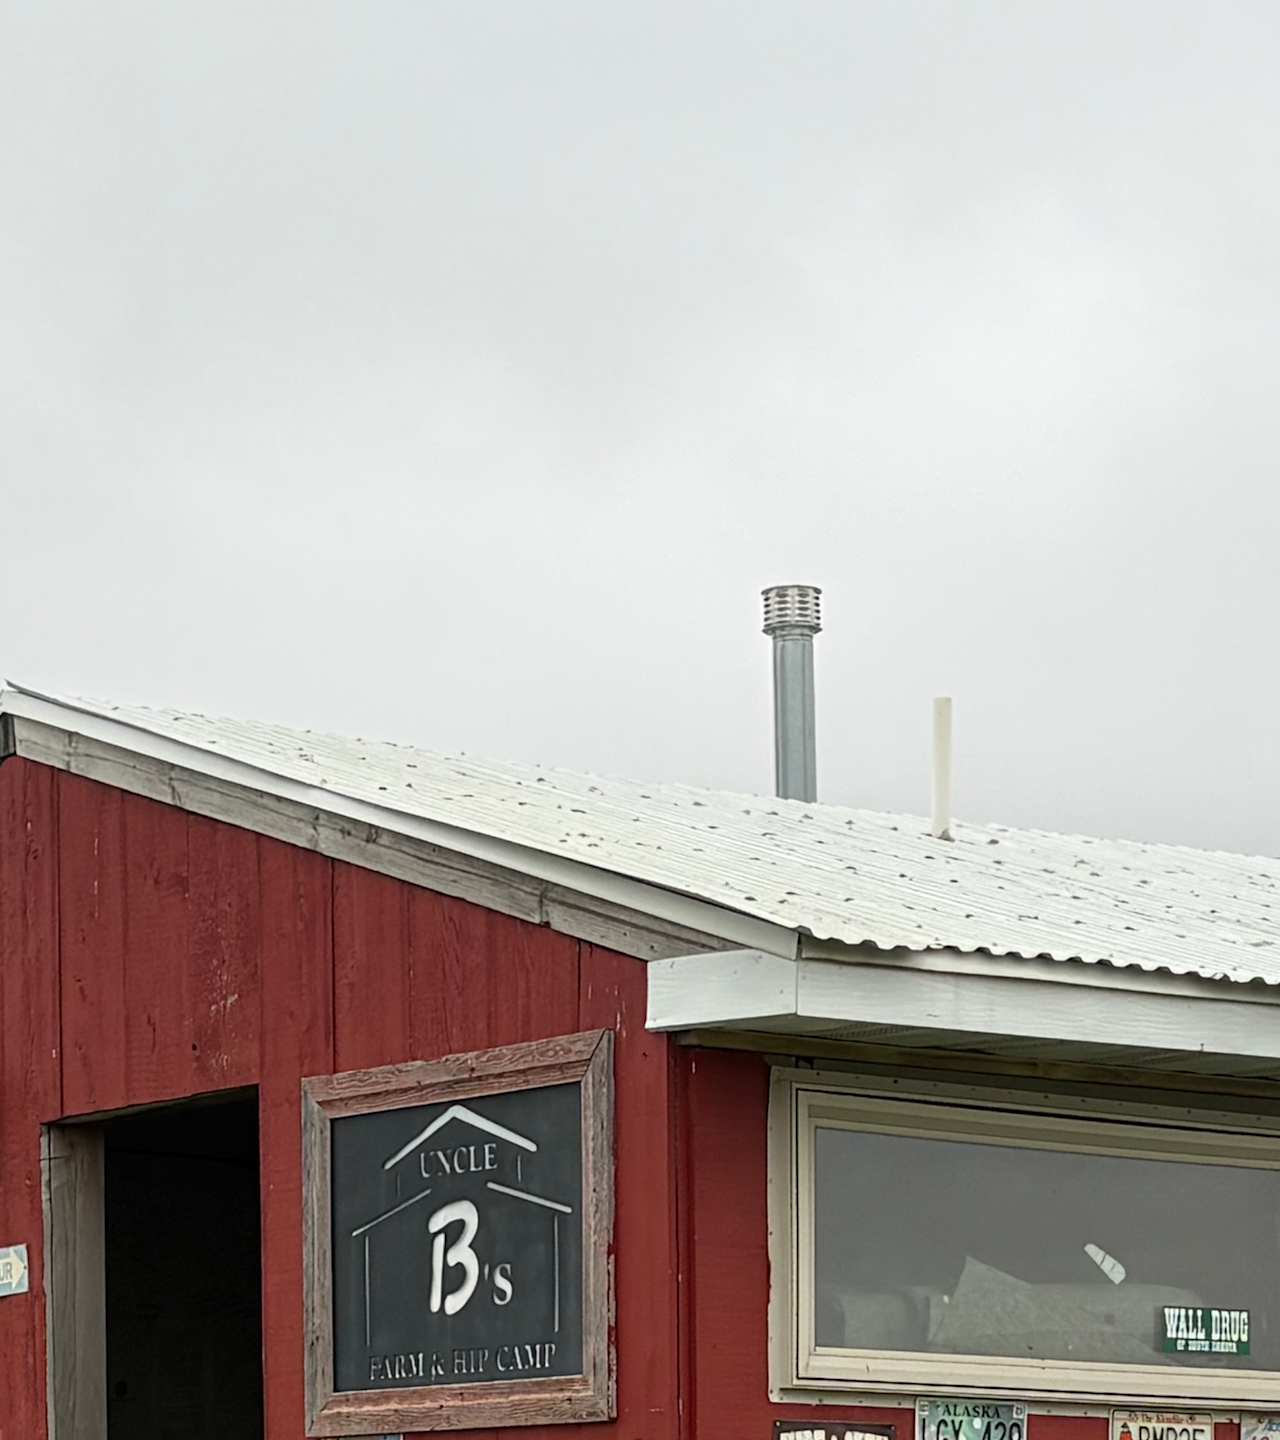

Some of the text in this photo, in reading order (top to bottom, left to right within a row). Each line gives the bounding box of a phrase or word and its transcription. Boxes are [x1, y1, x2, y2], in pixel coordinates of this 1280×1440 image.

[419, 1143, 498, 1180] UNCLE
[1164, 1307, 1249, 1342] WALL DRUG
[369, 1343, 557, 1381] FARM & HIP CAMP
[942, 1404, 1000, 1418] ALASKA
